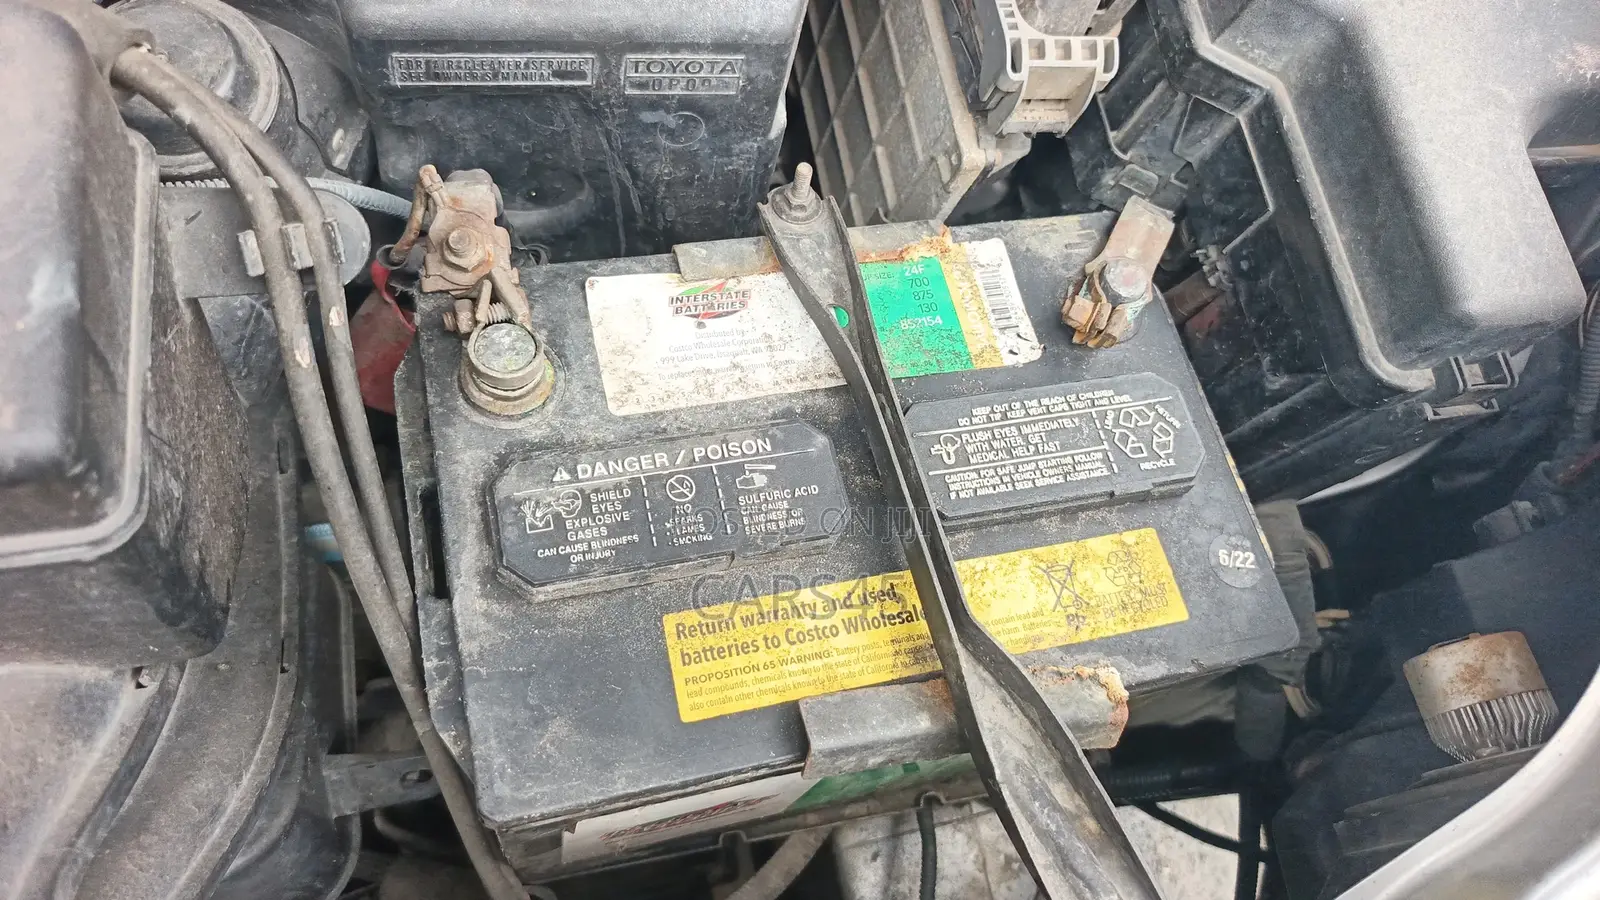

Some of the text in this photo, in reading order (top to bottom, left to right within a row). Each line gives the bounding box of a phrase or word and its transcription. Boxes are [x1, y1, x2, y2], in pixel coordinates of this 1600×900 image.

[398, 58, 586, 70] FOR AIR CLEANER SERVICE
[632, 59, 739, 75] TOYOTA
[400, 71, 553, 83] SEE OWNERS MANUAL
[903, 263, 925, 277] 24F
[907, 276, 930, 289] 700
[669, 289, 751, 306] INTERSTATE
[912, 288, 934, 301] 875
[674, 299, 747, 316] BATTERIES
[917, 301, 939, 314] 130
[694, 328, 736, 340] Distributed
[668, 344, 693, 354] Costco
[694, 339, 732, 351] Wholesale
[660, 355, 677, 365] 999
[677, 352, 694, 364] Lake
[971, 388, 1115, 417] KEEP OUT OF THE REACH OF CHILDREN
[957, 417, 970, 427] DO
[971, 414, 988, 425] NOT
[1006, 409, 1026, 420] KEEP
[1026, 406, 1047, 418] VENT
[1048, 403, 1070, 414] CAPS
[1071, 400, 1092, 411] TIGHT
[1094, 397, 1110, 407] AND
[1154, 403, 1182, 430] RETURN
[961, 416, 1080, 445] FLUSH EYES IMMEDIATELY
[963, 432, 1047, 455] WITH WATER. GET
[576, 452, 670, 480] DANGER
[692, 437, 772, 463] POISON
[968, 440, 1062, 465] MEDICAL HELP FAST
[980, 469, 996, 479] FOR
[996, 466, 1016, 477] SAFE
[1016, 463, 1037, 474] JUMP
[1038, 457, 1073, 471] STARTING
[1073, 451, 1104, 465] FOLLOW
[1139, 457, 1177, 471] RECYCLE
[947, 477, 1001, 492] INSTRUCTIONS
[1001, 475, 1011, 484] IN
[1011, 470, 1042, 483] VEHICLE
[949, 491, 958, 500] IF
[958, 489, 975, 499] NOT
[976, 483, 1014, 497] AVAILABLE
[1014, 480, 1035, 491] SEEK
[1034, 476, 1065, 488] SERVICE
[589, 488, 632, 503] SHIELD
[738, 484, 819, 506] SULFURIC ACID
[591, 500, 622, 514] EYES
[675, 503, 692, 515] NO
[762, 500, 789, 511] CAUSE
[565, 510, 631, 530] EXPLOSIVE
[743, 510, 788, 525] BLINDNESS
[567, 526, 608, 542] GASES
[744, 521, 777, 536] SEVERE
[537, 533, 640, 558] CAN CAUSE BLINDNESS
[672, 533, 713, 546] SMOKING
[569, 548, 617, 564] OR INJURY
[1217, 548, 1258, 569] 6/22
[1094, 581, 1169, 607] BATTER MUST
[674, 582, 898, 642] Return warranty and used
[1065, 612, 1087, 627] Pb
[1102, 605, 1117, 619] BE
[679, 603, 927, 668] batteries to Costco Wholesale
[684, 662, 761, 687] PROPOSITION
[762, 659, 777, 672] 65
[777, 651, 835, 668] WARNING:
[835, 643, 861, 658] Battery
[861, 640, 883, 654] posts,
[990, 613, 1015, 627] contain
[1015, 609, 1032, 622] lead
[1031, 606, 1045, 619] and
[686, 688, 704, 699] lead
[704, 680, 751, 697] compounds,
[751, 670, 788, 686] chemicals
[812, 664, 822, 674] to
[822, 662, 834, 672] the
[835, 658, 852, 670] state
[852, 654, 861, 666] of
[1022, 619, 1052, 632] Batteries
[689, 699, 704, 711] also
[705, 695, 734, 709] contain
[734, 691, 755, 703] other
[755, 682, 791, 700] chemicals
[825, 673, 838, 683] the
[838, 668, 857, 680] state
[857, 664, 867, 677] of
